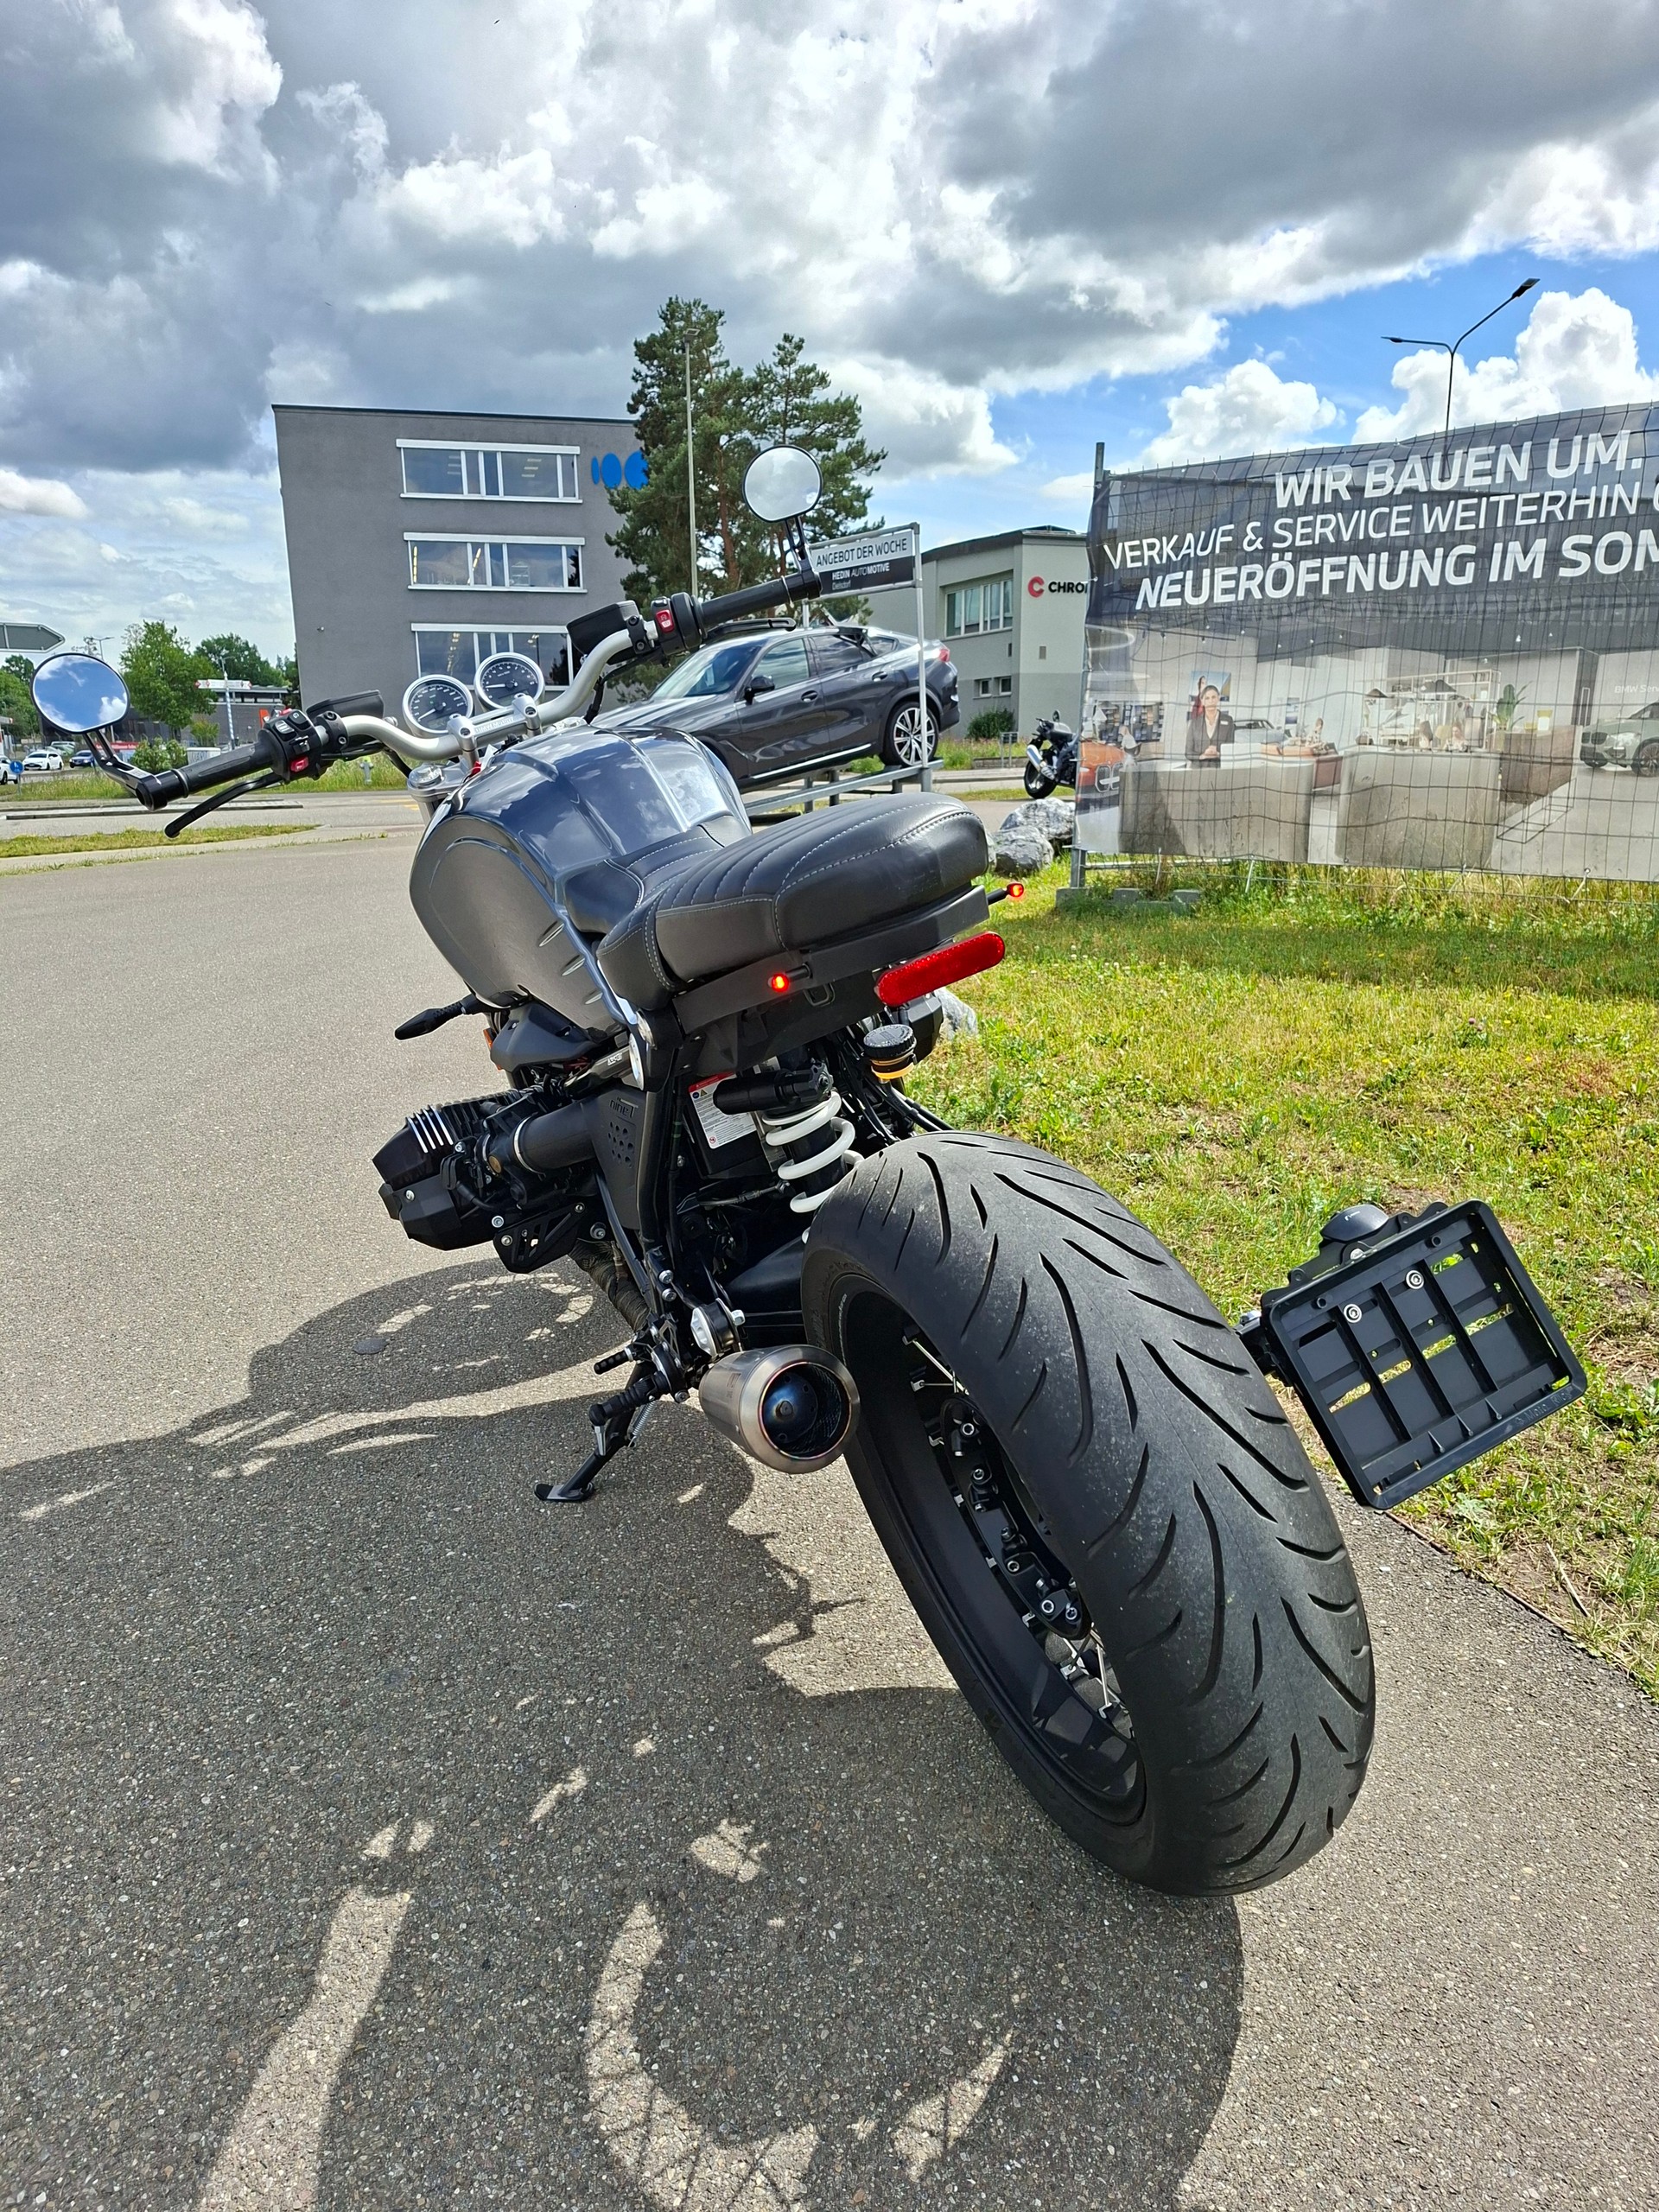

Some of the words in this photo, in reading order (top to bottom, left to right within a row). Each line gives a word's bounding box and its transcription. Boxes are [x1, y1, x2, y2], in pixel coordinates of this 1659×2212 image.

[1275, 463, 1352, 508] WIR
[1363, 442, 1533, 499] BAUEN
[1547, 429, 1643, 479] UM.
[1103, 524, 1235, 569] VERKAUF
[1243, 521, 1264, 552] &
[1272, 505, 1413, 549] SERVICE
[1422, 481, 1640, 533] WEITERHIN
[816, 548, 855, 567] ANGEBOT
[857, 544, 874, 559] DER
[875, 538, 907, 556] WOCHE
[832, 569, 850, 580] HEDIN
[851, 563, 890, 577] AUTOMOTIVE
[1135, 544, 1477, 610] NEUERÖFFNUNG
[1489, 538, 1547, 582] IM
[1048, 581, 1088, 594] CHRO
[1614, 684, 1638, 694] BMW
